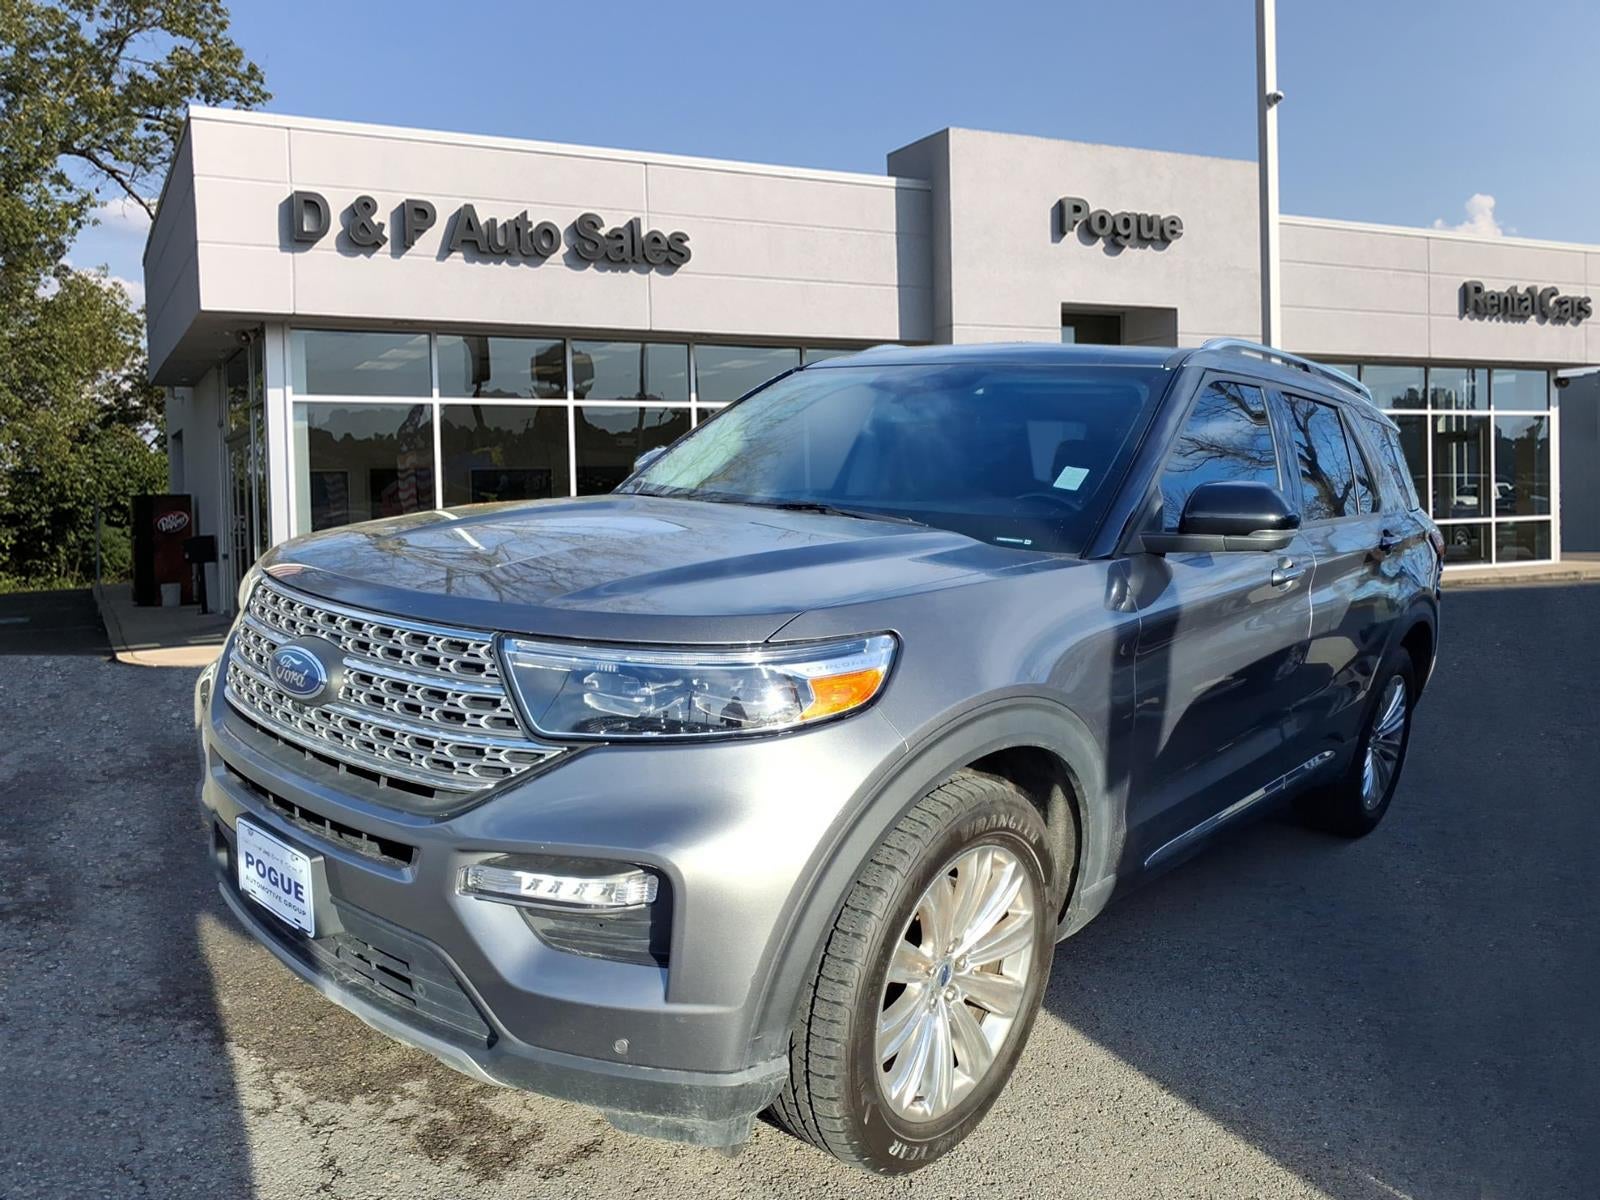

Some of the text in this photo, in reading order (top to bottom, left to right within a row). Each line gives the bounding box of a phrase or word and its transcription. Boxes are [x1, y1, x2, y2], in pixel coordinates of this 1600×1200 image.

[293, 190, 692, 268] D & P Auto Sales
[1061, 196, 1184, 249] Pogue
[1463, 280, 1593, 324] Rental Cars
[275, 654, 309, 688] Ford
[244, 851, 306, 904] POGUE
[283, 898, 307, 916] GROUP
